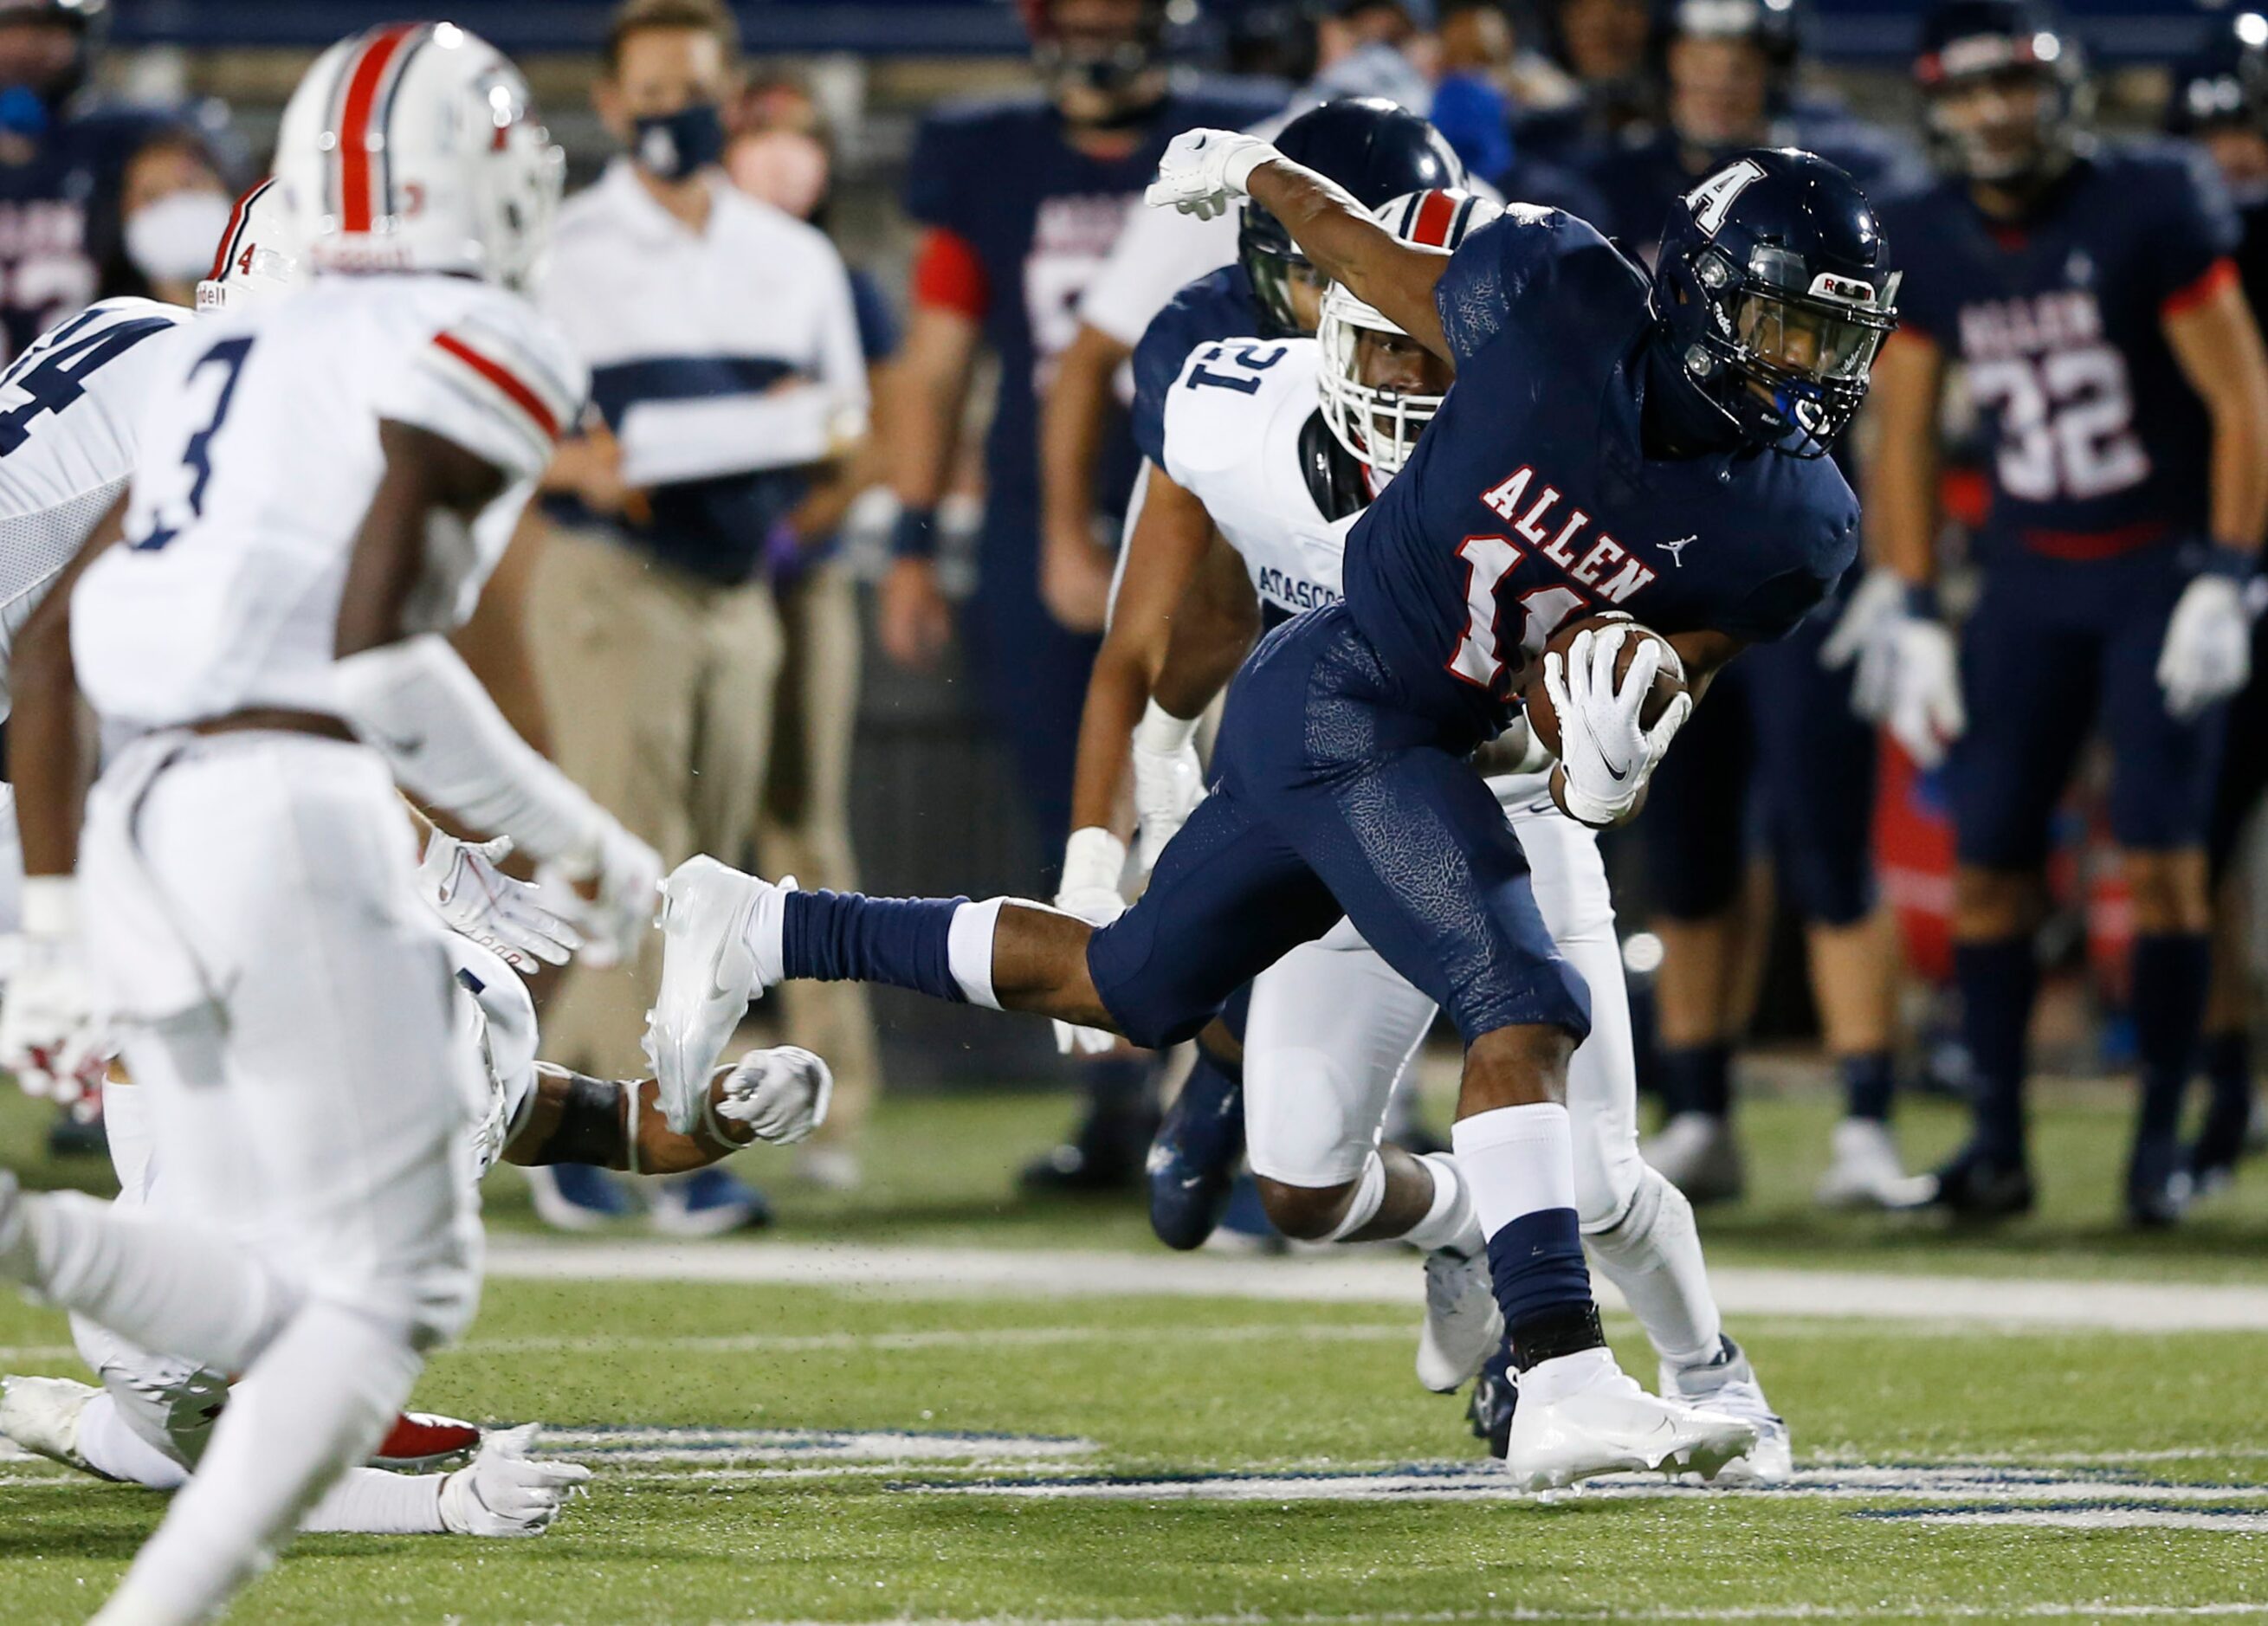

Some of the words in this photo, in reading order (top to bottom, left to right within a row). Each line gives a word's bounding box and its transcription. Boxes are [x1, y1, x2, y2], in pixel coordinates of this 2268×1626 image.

[1678, 158, 1768, 239] A
[237, 242, 256, 276] 4
[1186, 345, 1289, 397] 21
[132, 332, 256, 552] 3
[1962, 348, 2151, 499] 32
[1479, 464, 1657, 604] ALLEN
[1260, 565, 1346, 610] ATASCO
